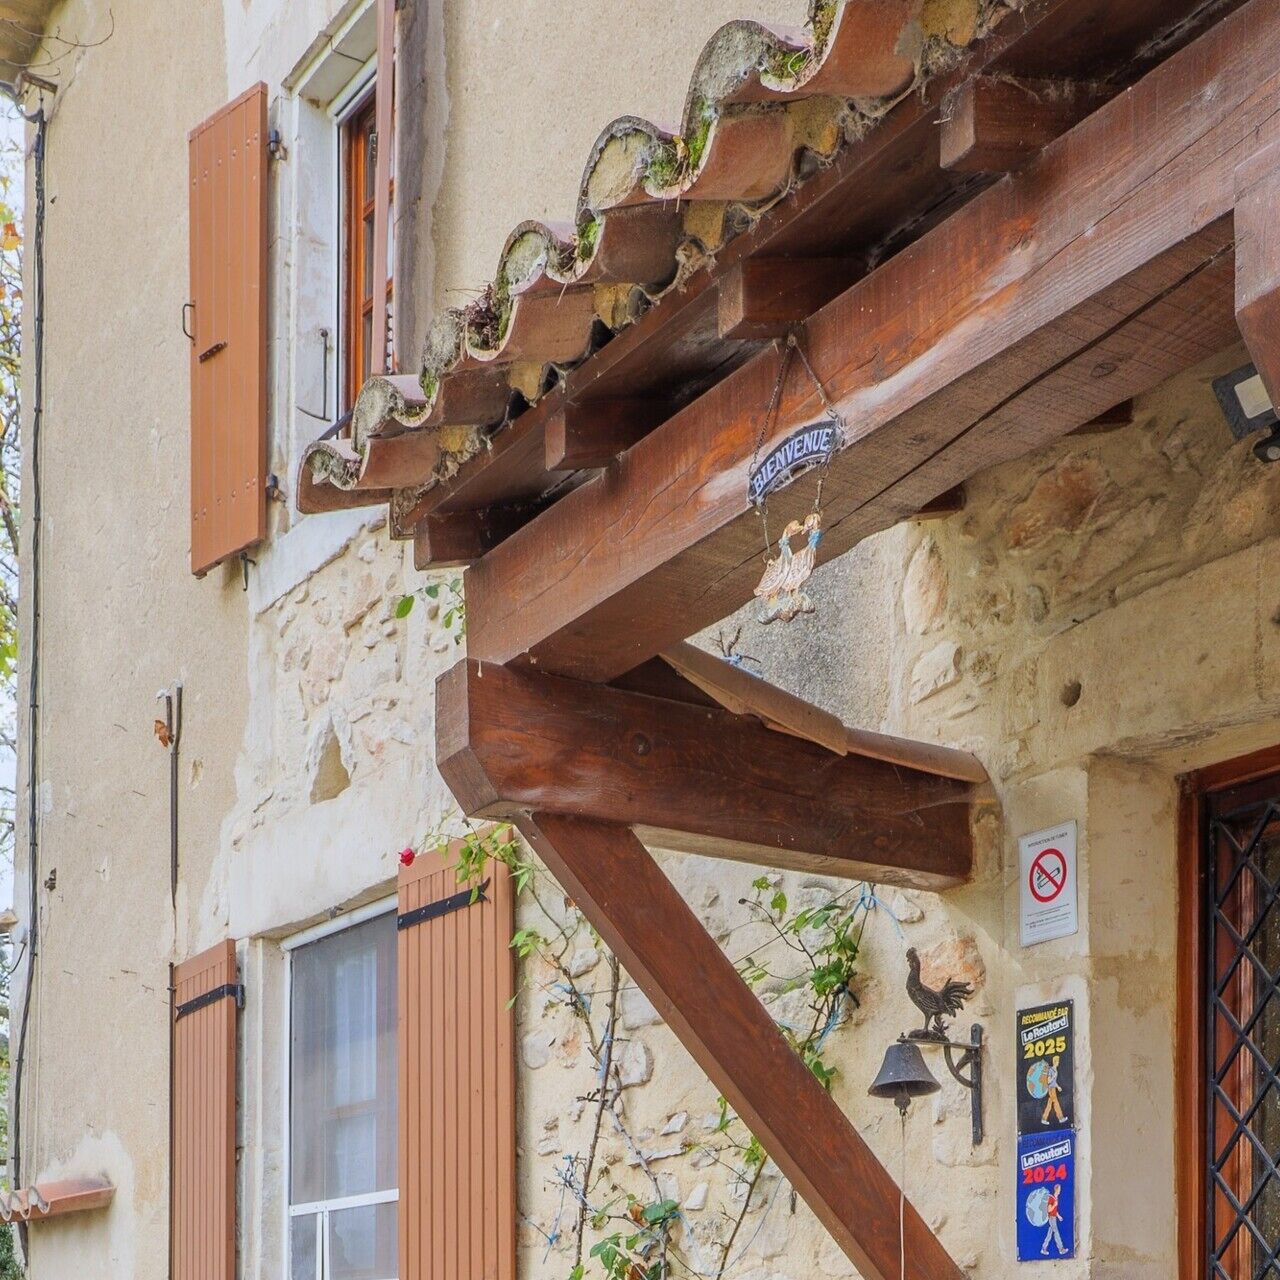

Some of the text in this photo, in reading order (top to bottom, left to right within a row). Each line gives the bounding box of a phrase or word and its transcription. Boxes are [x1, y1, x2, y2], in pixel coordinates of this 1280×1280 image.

[752, 428, 834, 495] BIENVENUE
[1022, 1008, 1057, 1025] RECOMMANDÉ
[1024, 1036, 1066, 1059] 2025
[1023, 1163, 1067, 1185] 2024
